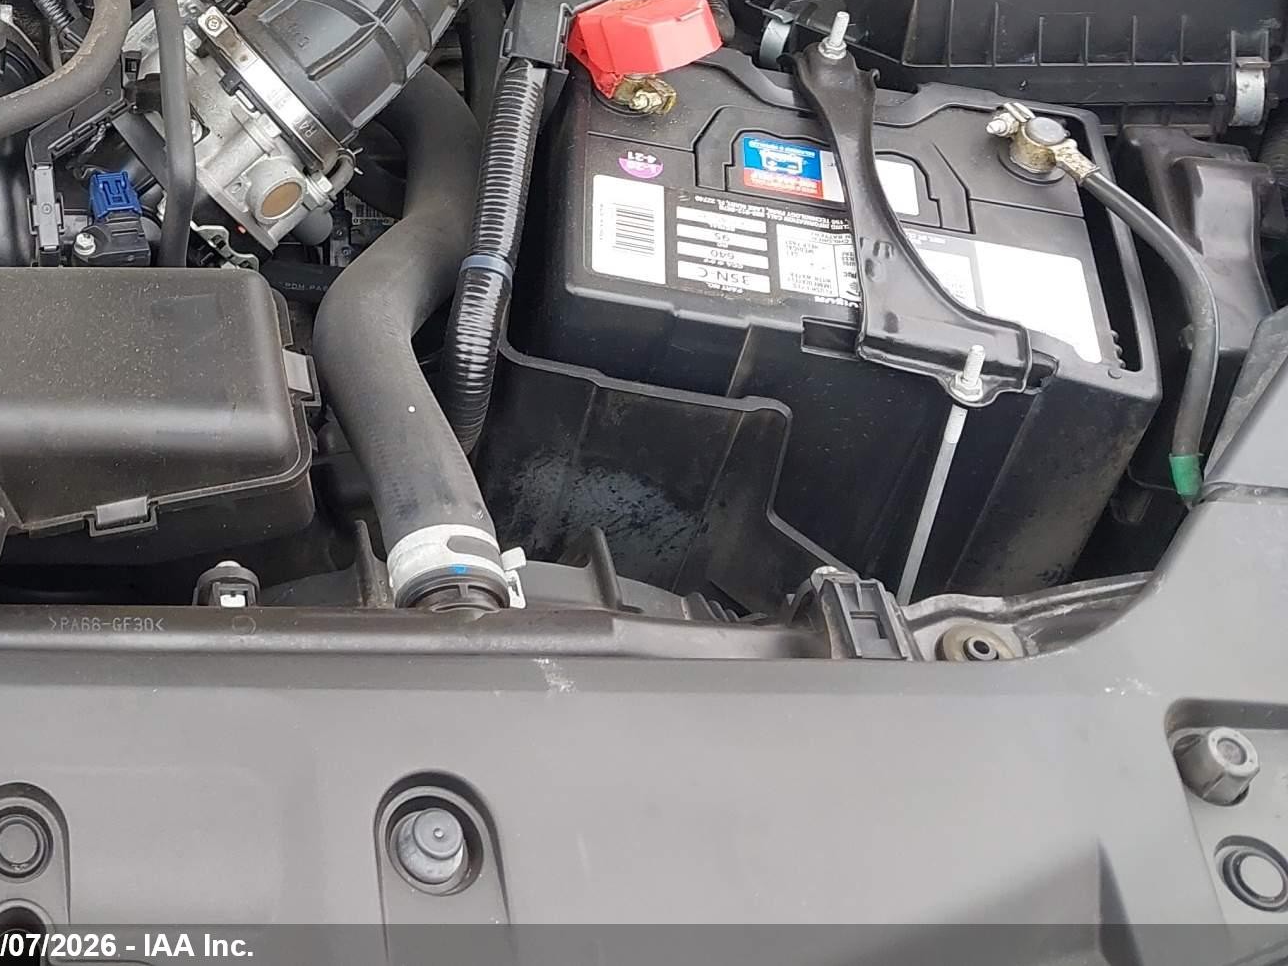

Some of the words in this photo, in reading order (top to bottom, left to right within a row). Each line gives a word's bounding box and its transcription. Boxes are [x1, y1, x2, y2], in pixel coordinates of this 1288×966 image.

[627, 151, 657, 164] 4-21
[713, 233, 731, 243] 95
[710, 249, 735, 260] 640
